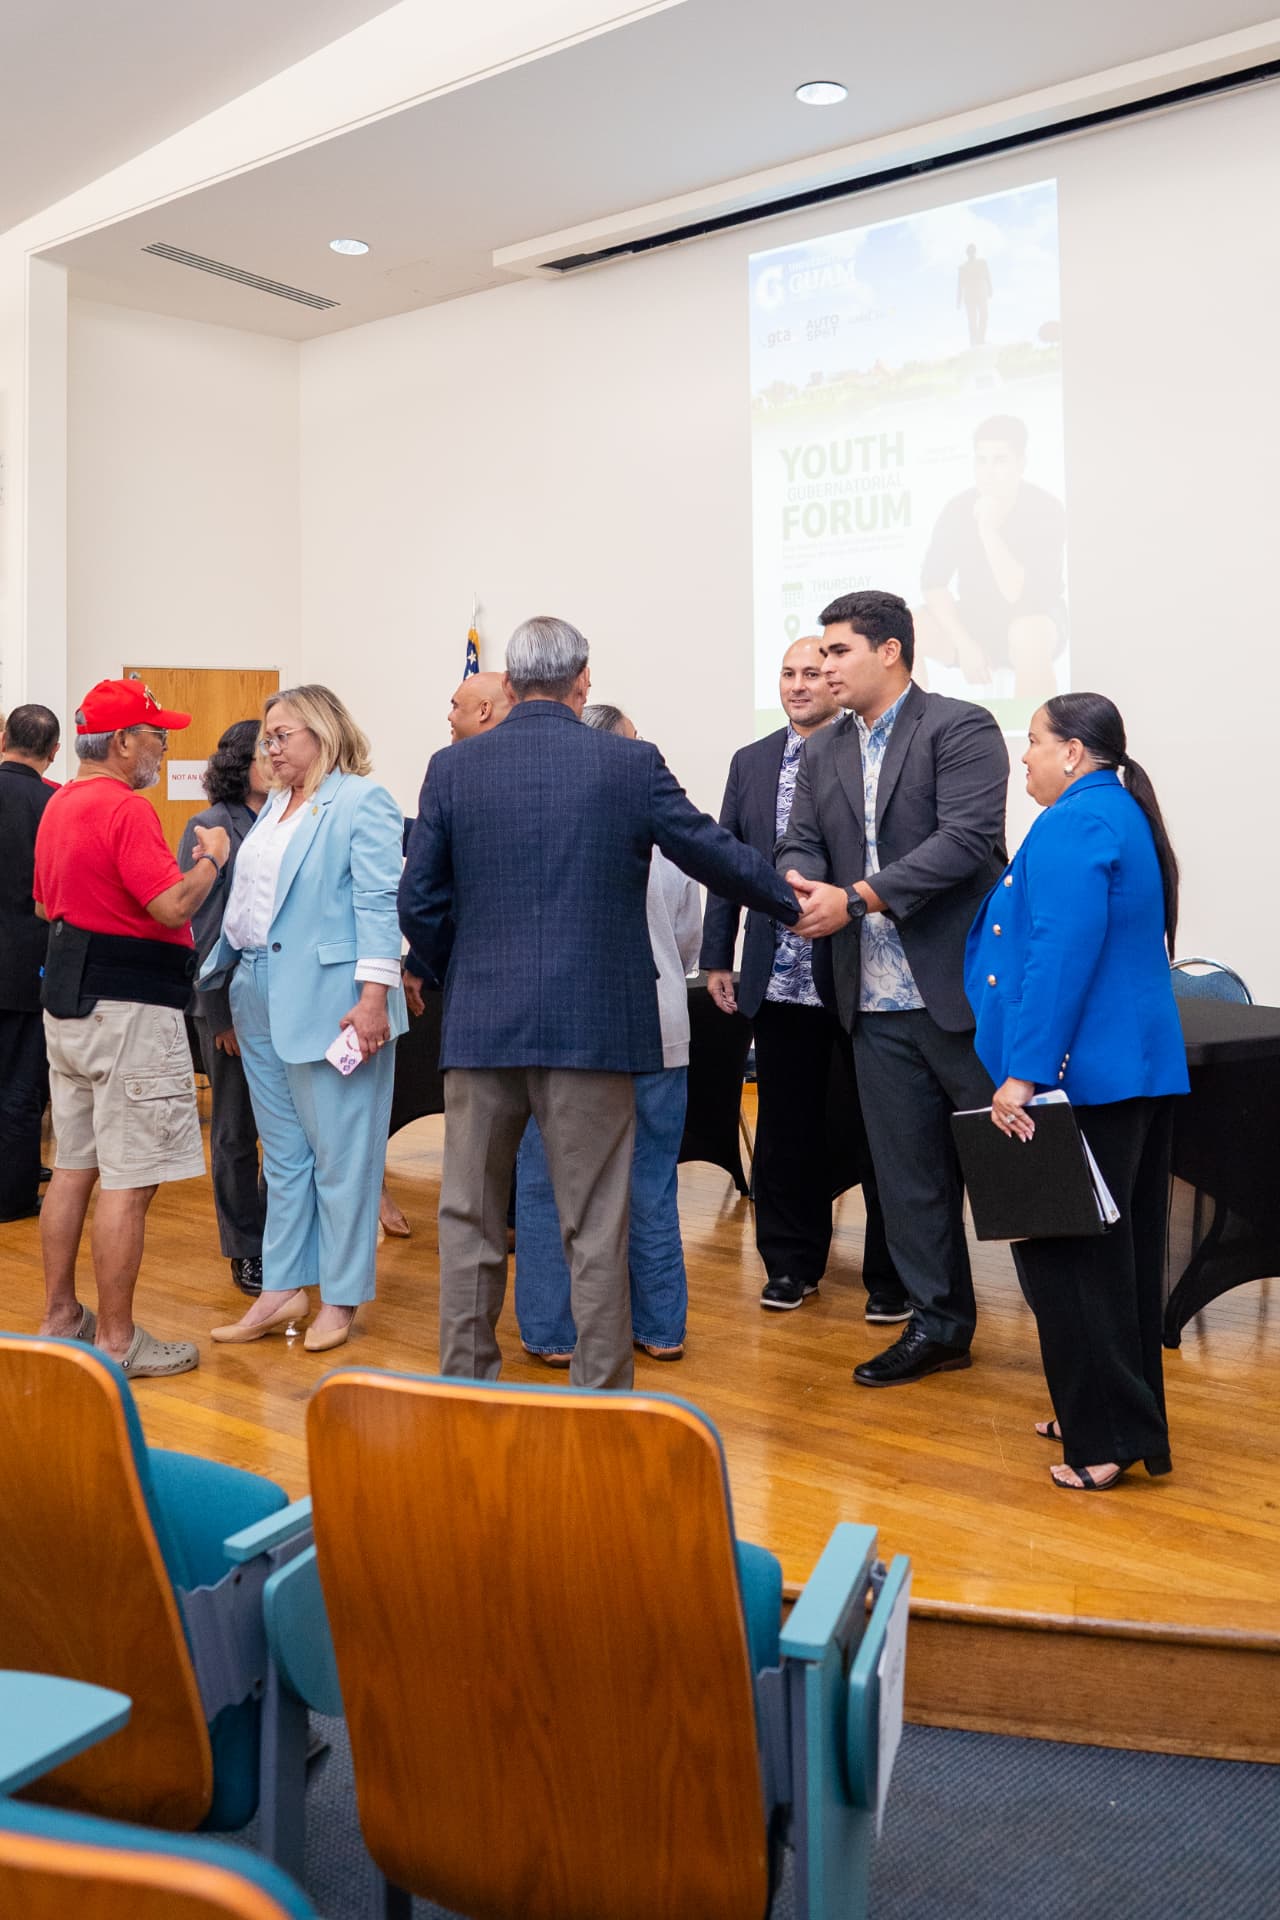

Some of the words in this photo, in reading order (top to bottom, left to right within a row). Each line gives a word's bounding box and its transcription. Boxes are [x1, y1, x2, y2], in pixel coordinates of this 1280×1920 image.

[806, 314, 840, 330] AUTO
[767, 328, 792, 349] gta
[779, 430, 905, 482] YOUTH
[787, 471, 904, 502] GUBERNATORIAL
[782, 489, 912, 541] FORUM
